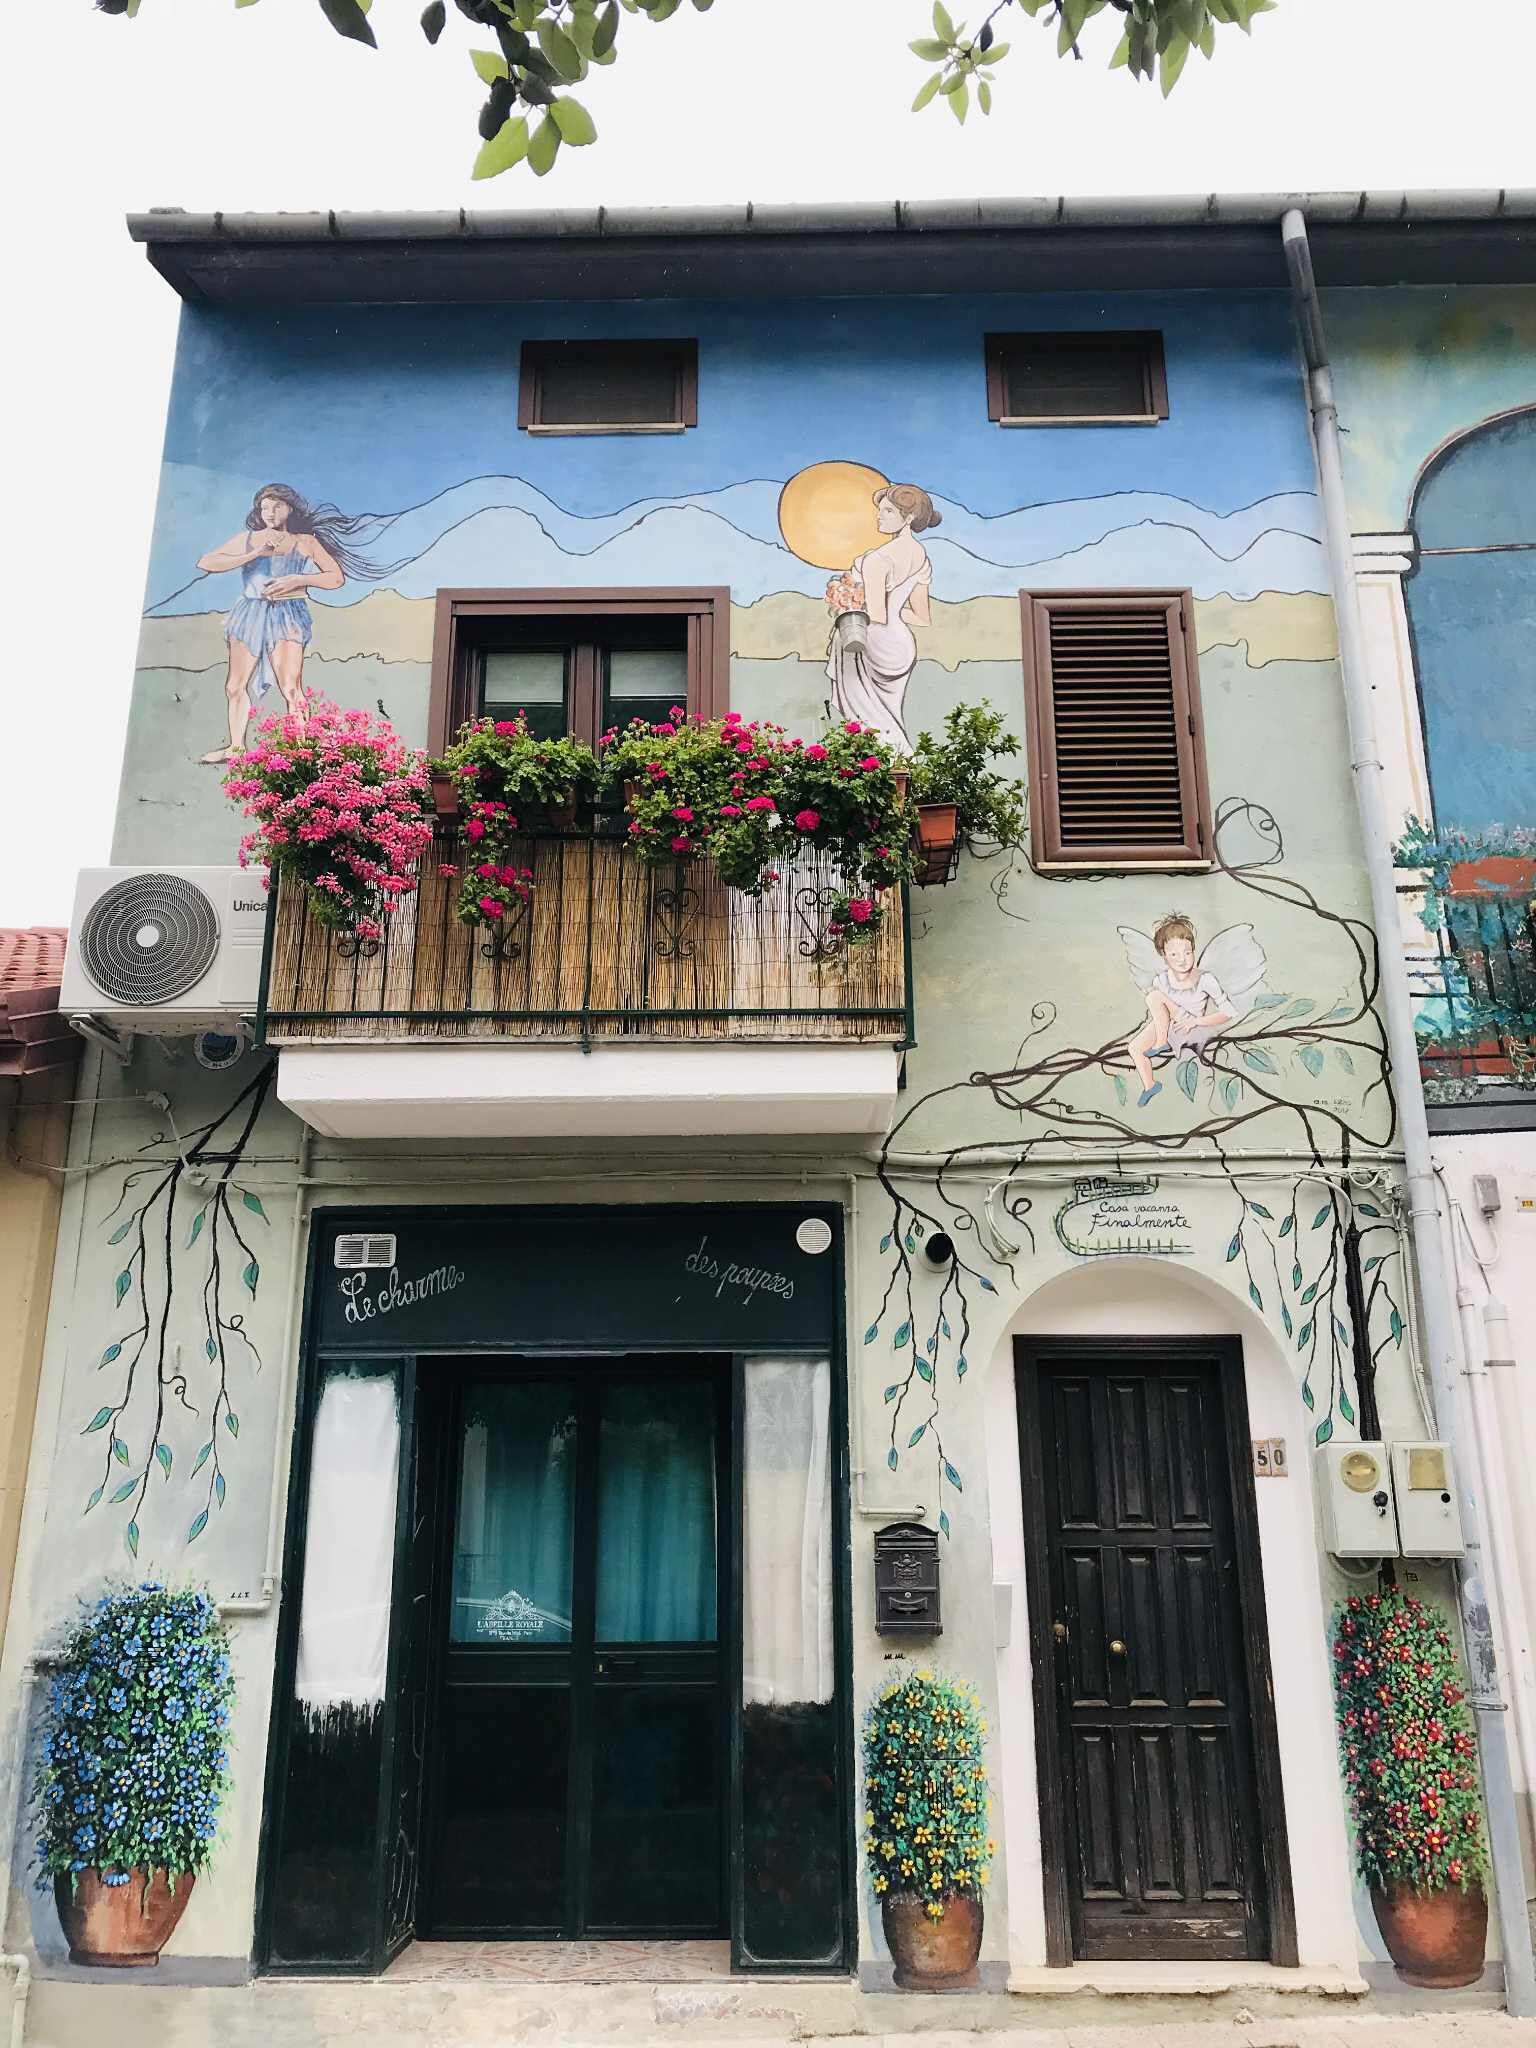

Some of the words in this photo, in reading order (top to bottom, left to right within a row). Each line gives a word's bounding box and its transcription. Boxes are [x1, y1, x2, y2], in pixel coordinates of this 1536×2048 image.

[1099, 1201, 1129, 1213] Casa
[1088, 1213, 1192, 1236] Finalmente
[686, 1235, 719, 1278] des
[338, 1271, 376, 1323] Le
[378, 1266, 465, 1313] charme
[1257, 1449, 1284, 1466] 50
[515, 1620, 544, 1629] ROYALE
